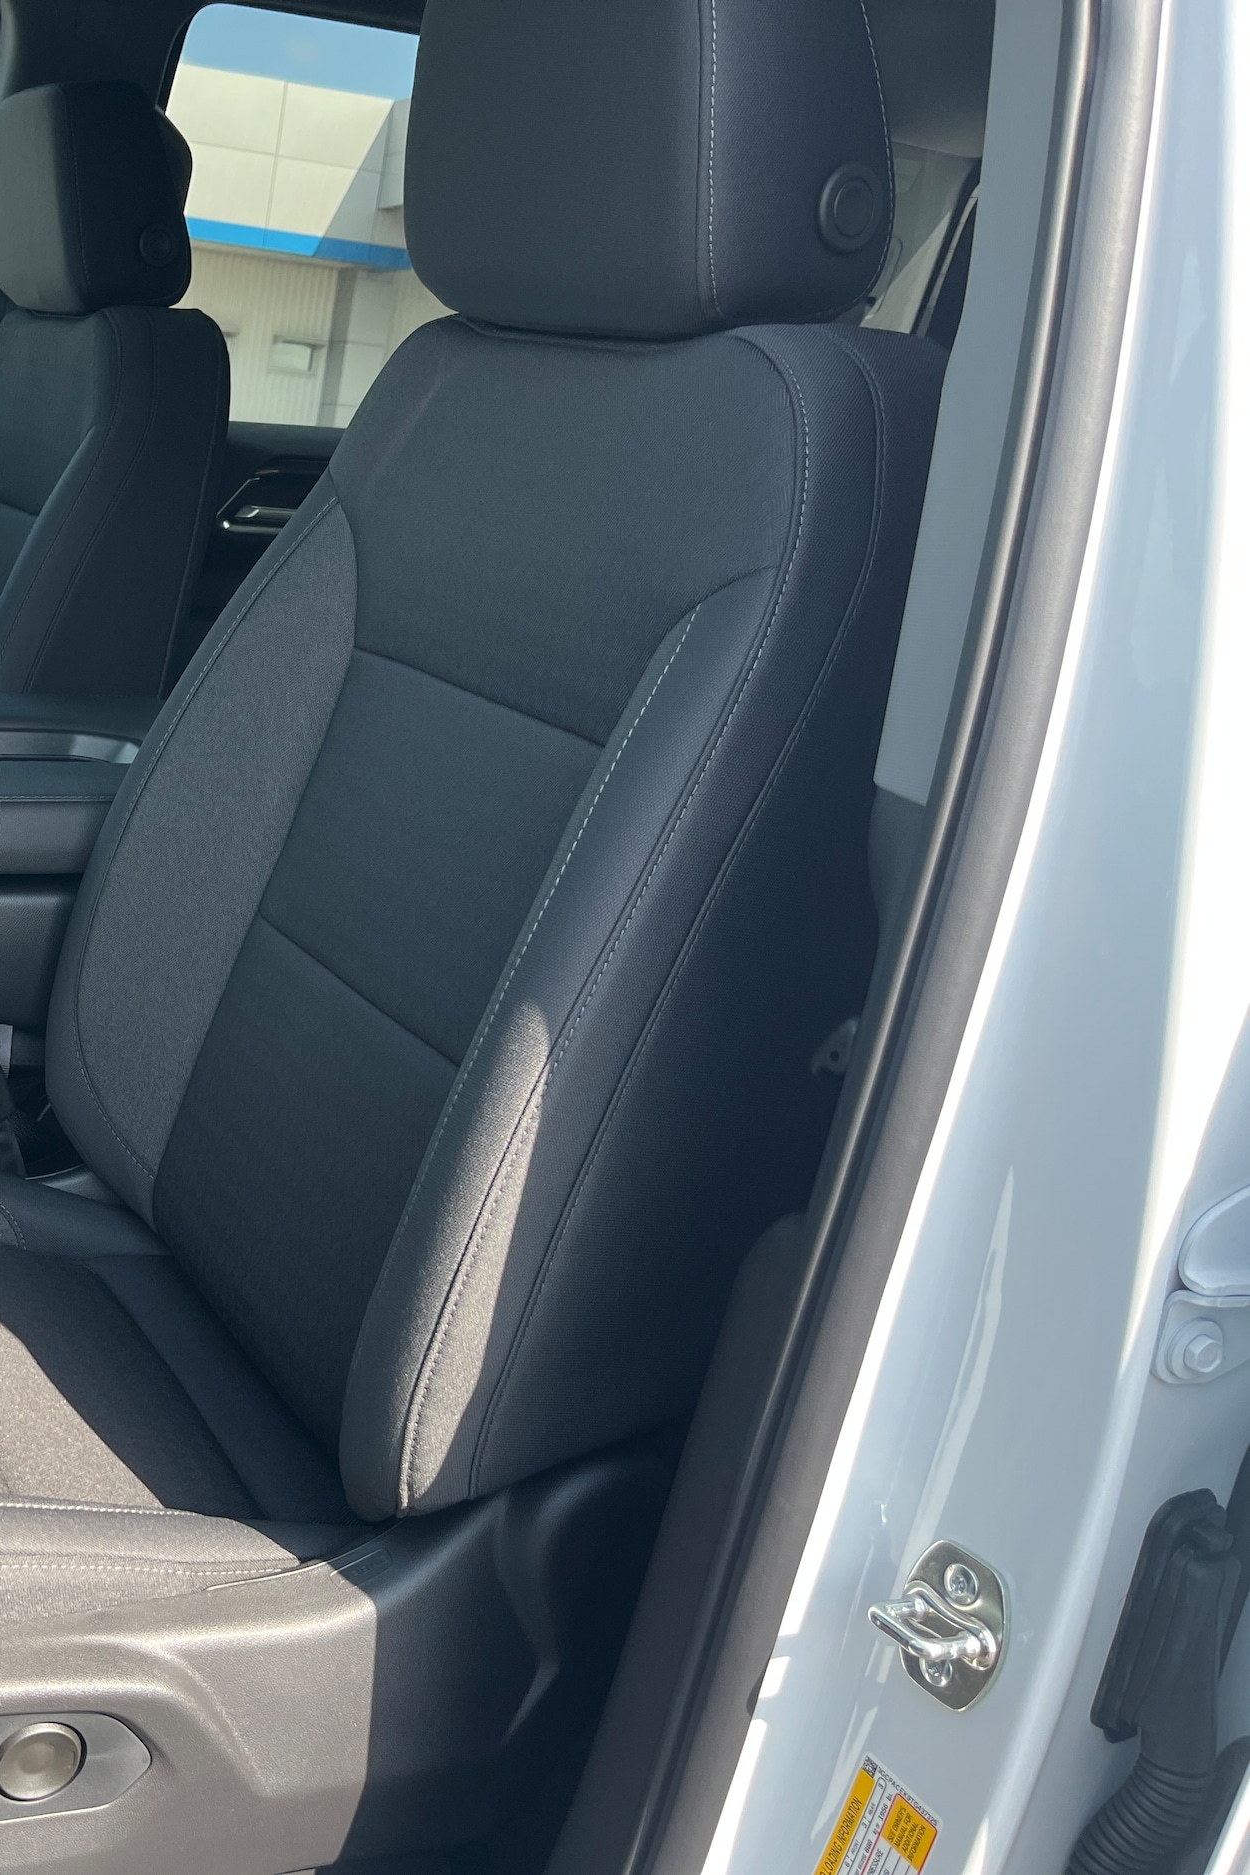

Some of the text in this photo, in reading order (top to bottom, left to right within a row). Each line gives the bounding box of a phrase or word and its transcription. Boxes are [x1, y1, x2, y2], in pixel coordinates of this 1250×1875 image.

[822, 1795, 863, 1875] LOADING INFORMATION
[894, 1825, 908, 1848] MANUAL
[901, 1822, 919, 1854] ADDITIONAL
[907, 1824, 927, 1862] INFORMATION
